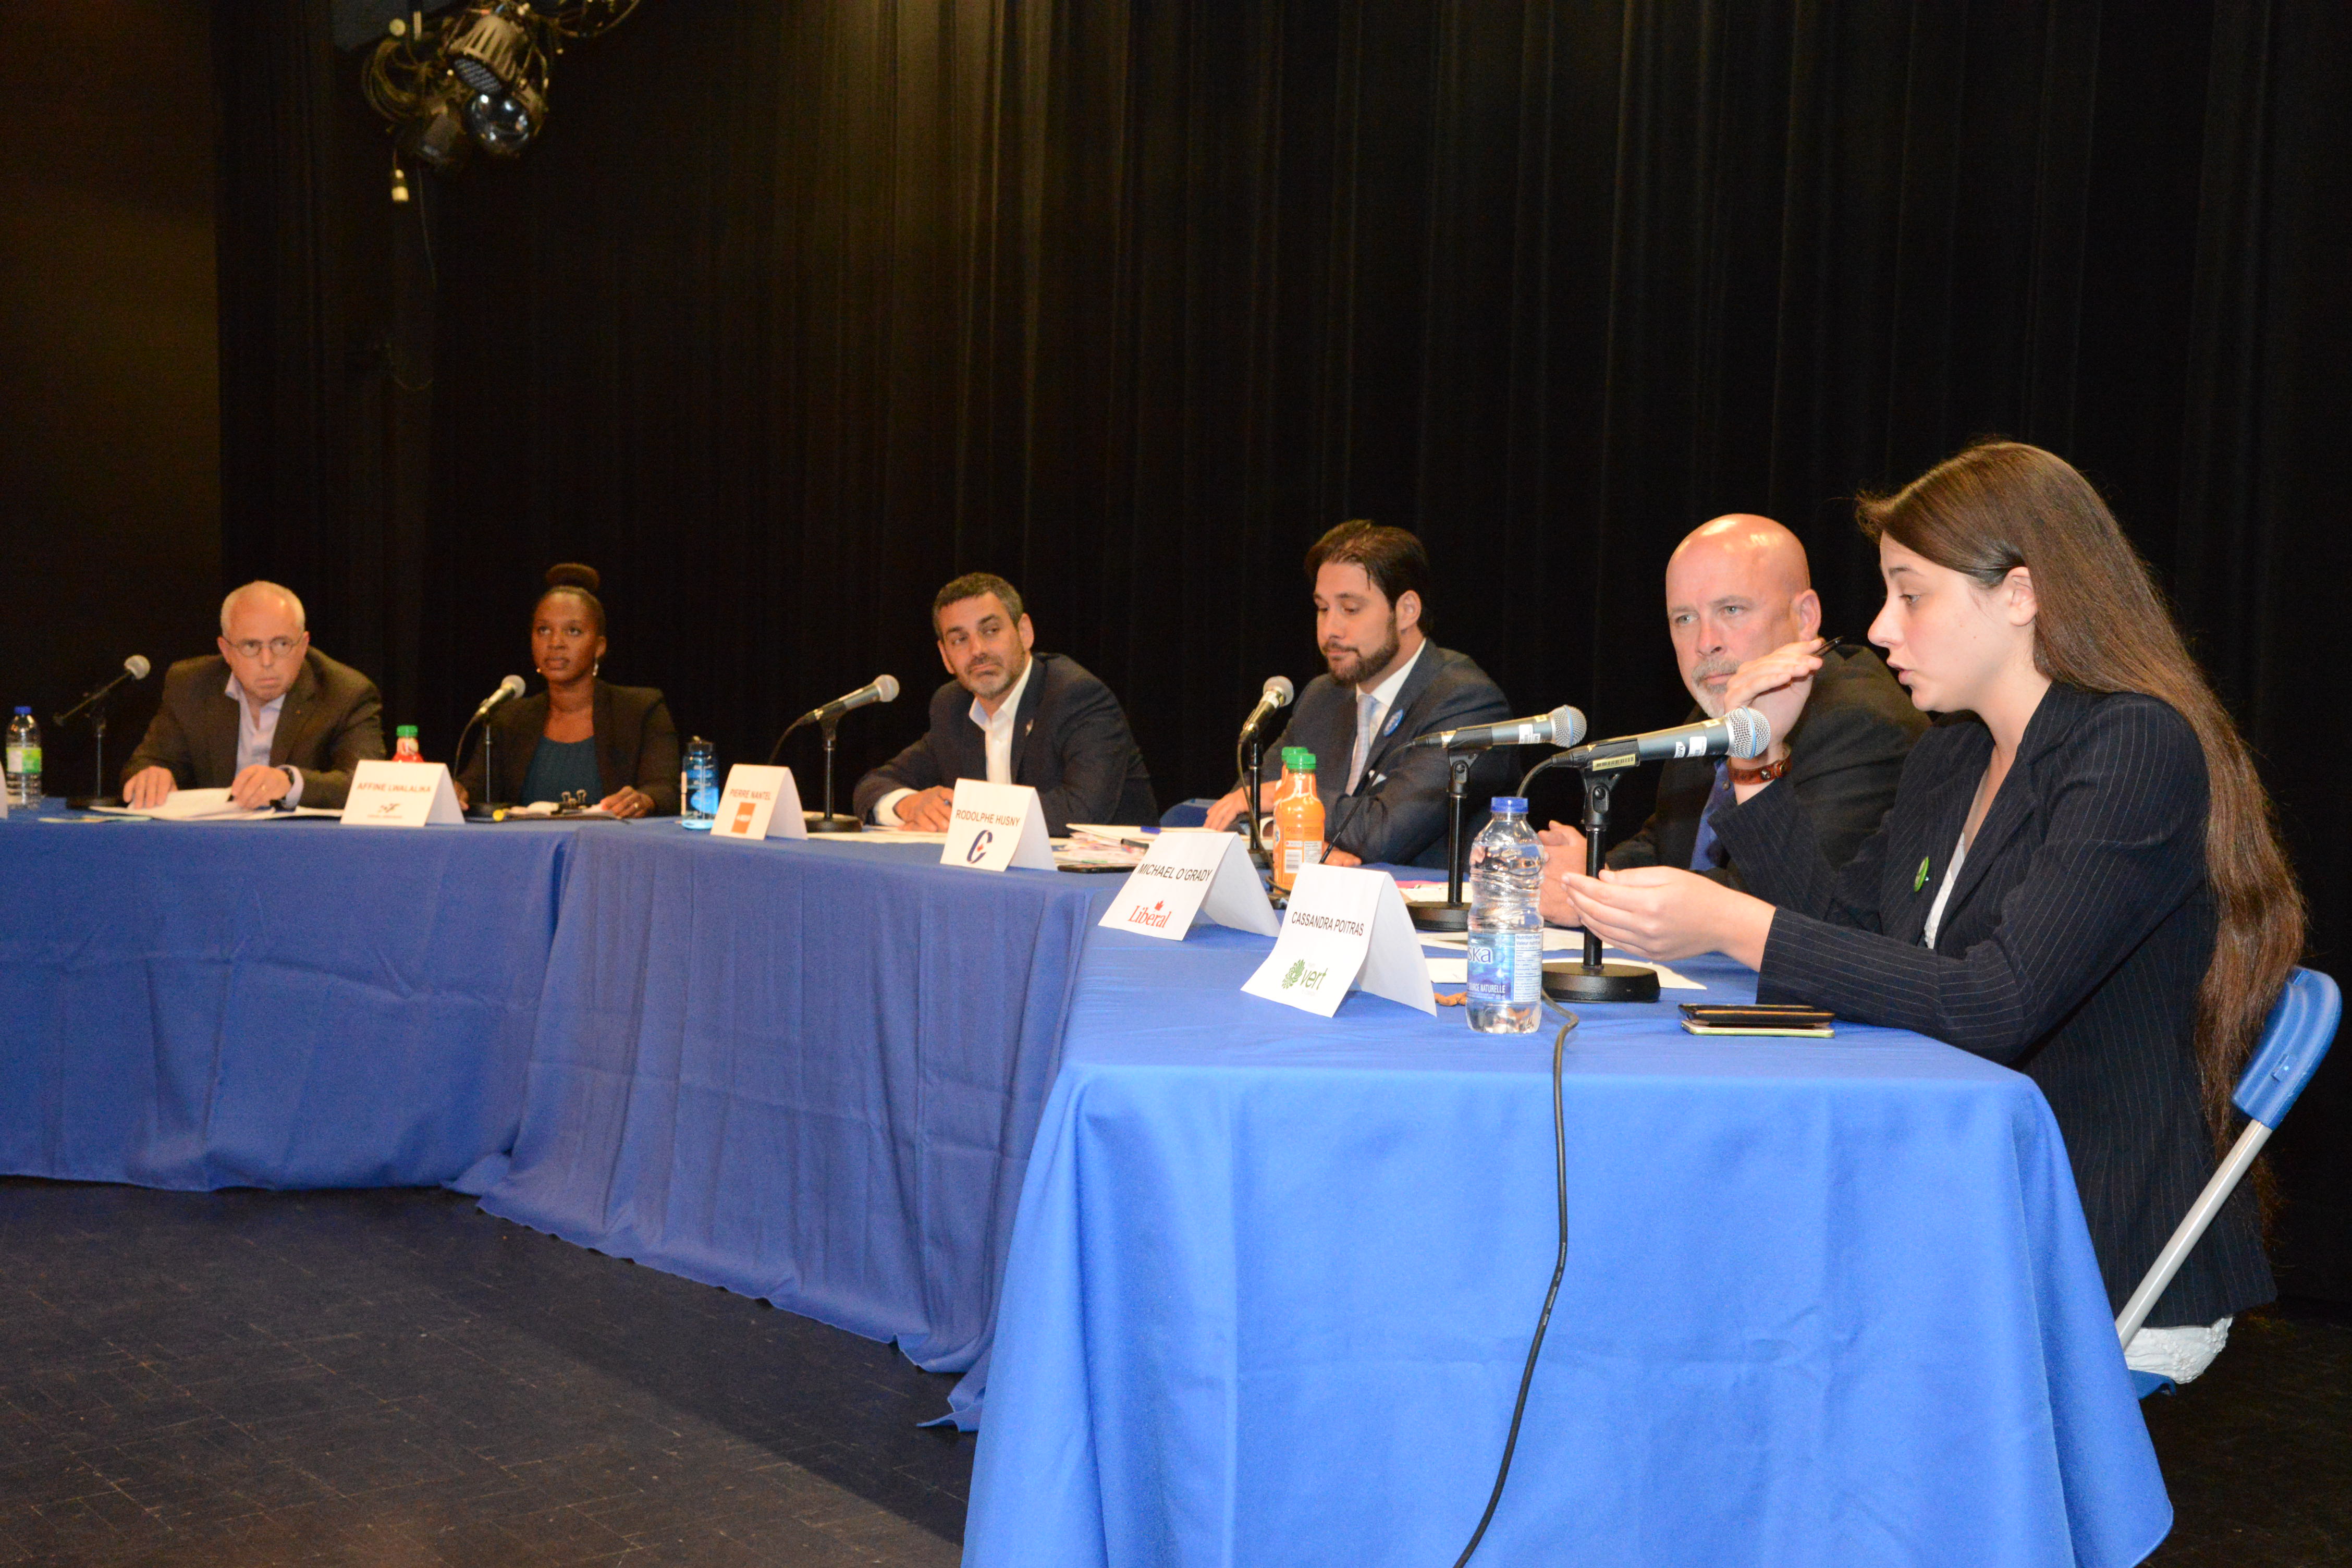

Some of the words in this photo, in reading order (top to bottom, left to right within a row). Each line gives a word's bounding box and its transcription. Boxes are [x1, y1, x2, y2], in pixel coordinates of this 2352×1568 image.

[357, 782, 386, 791] AFFINE
[729, 789, 750, 798] PIERRE
[751, 791, 770, 800] NANTEL
[956, 810, 995, 823] RODOLPHE
[996, 815, 1021, 827] HUSNY
[1137, 863, 1175, 879] MICHAEL
[1175, 868, 1212, 881] O'GRADY
[1128, 905, 1171, 928] Liberal
[1292, 912, 1333, 930] CASSANDRA
[1333, 919, 1364, 936] POITRAS
[1300, 967, 1328, 990] vert
[1480, 984, 1506, 994] NATURELLE
